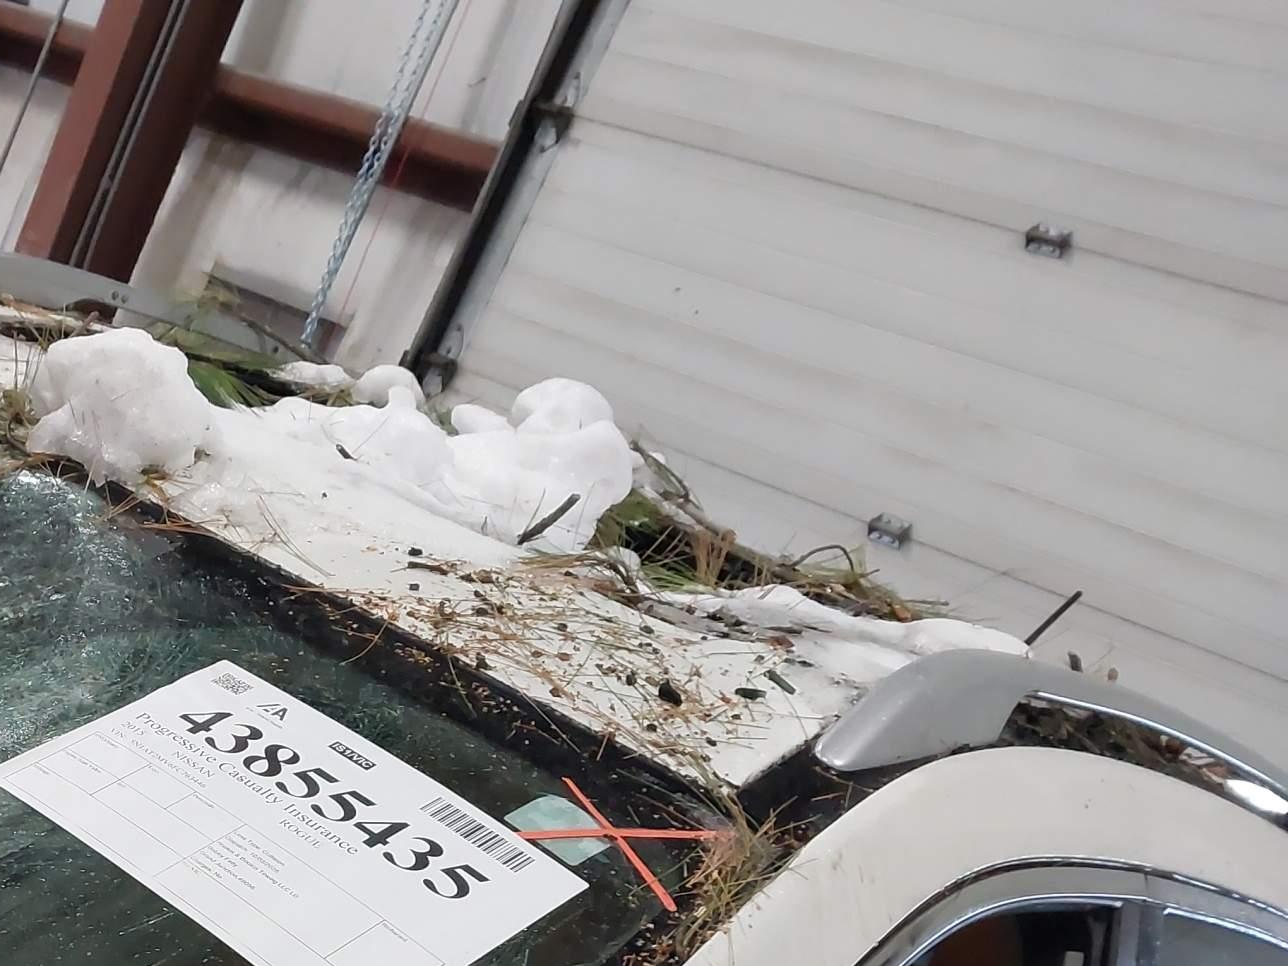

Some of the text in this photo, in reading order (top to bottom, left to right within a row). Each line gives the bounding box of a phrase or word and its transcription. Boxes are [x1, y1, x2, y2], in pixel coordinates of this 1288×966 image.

[120, 721, 321, 849] 2015 NISSAN ROGUE
[135, 712, 217, 763] Progressive
[218, 762, 284, 806] Casualty
[282, 804, 360, 856] Insurance
[179, 712, 491, 899] 43855435
